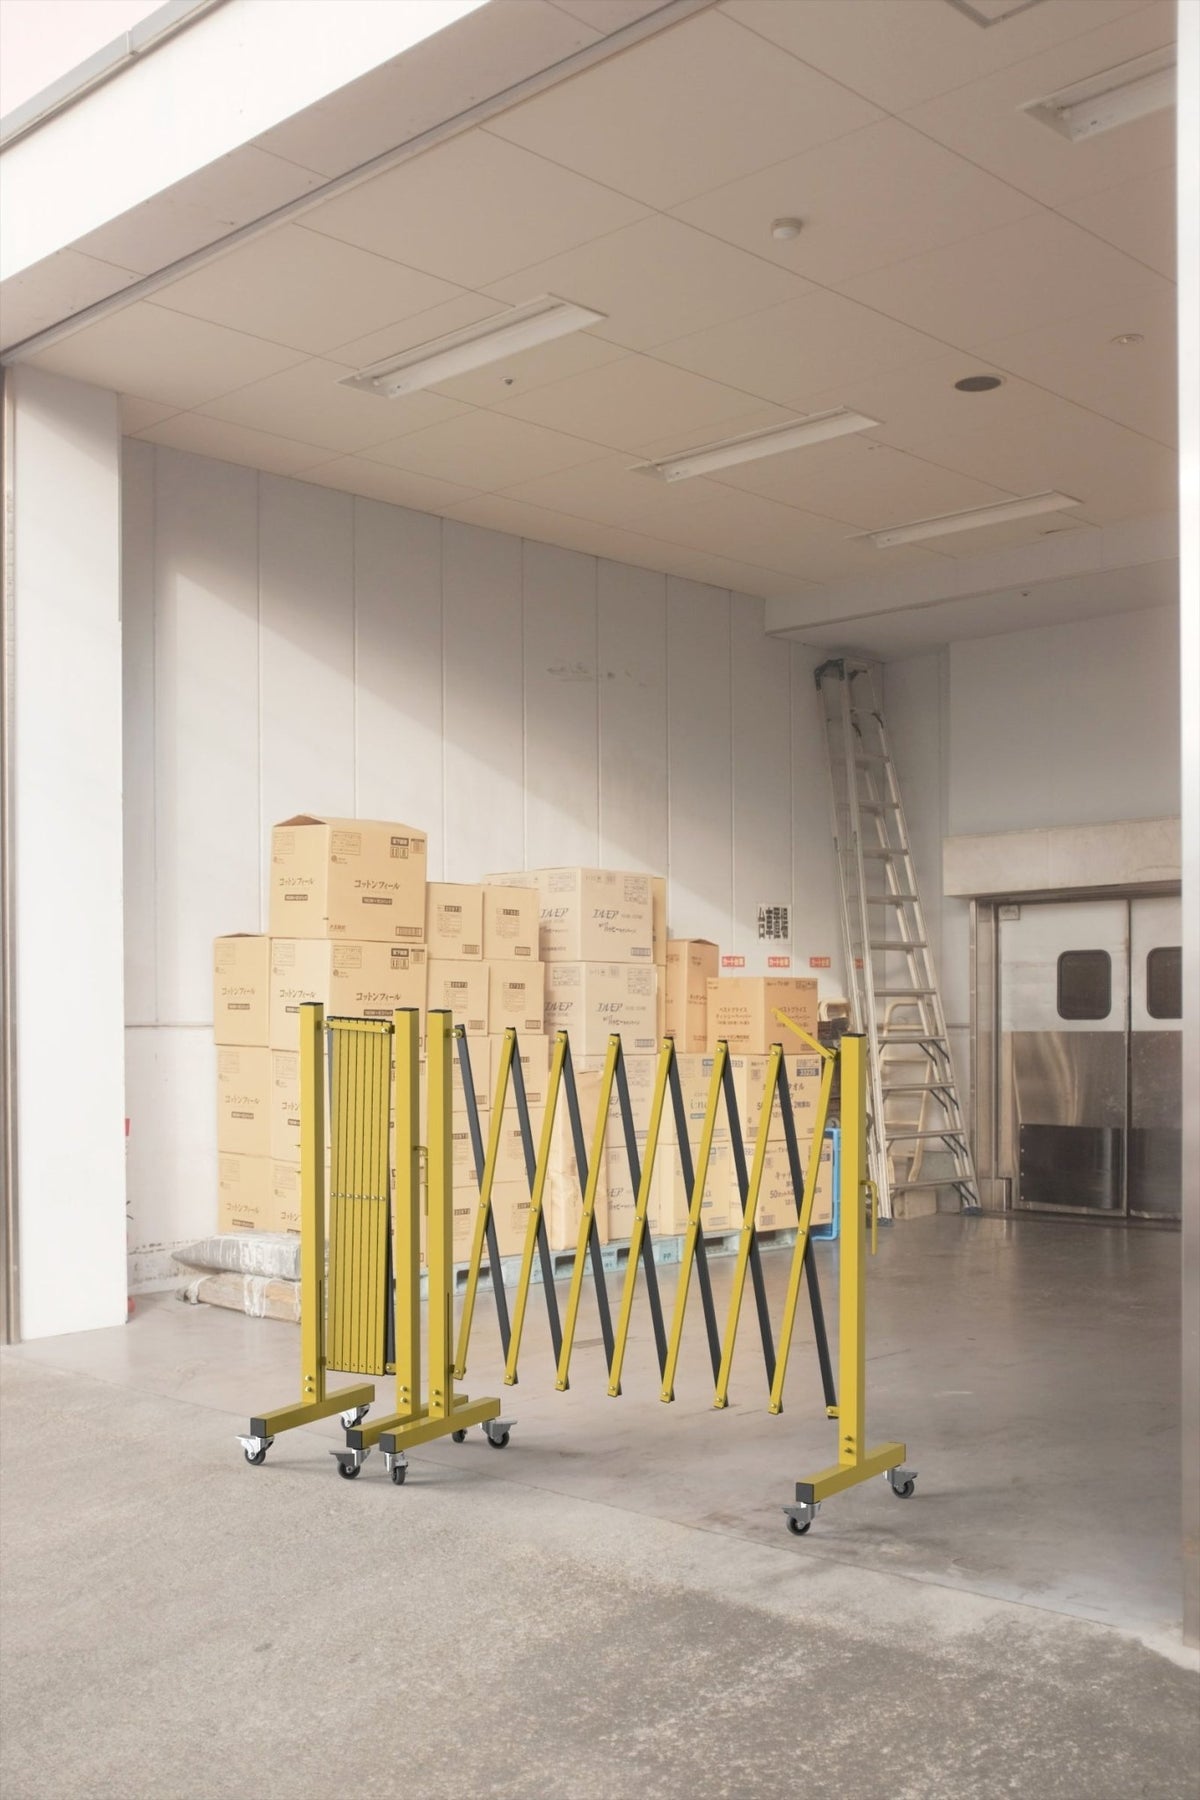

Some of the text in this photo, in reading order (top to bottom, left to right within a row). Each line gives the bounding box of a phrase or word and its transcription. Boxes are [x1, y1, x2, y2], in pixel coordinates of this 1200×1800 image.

[279, 877, 314, 886] コットンフィール
[354, 880, 400, 890] コットンフィール
[279, 989, 317, 998] コットンフィール
[356, 992, 401, 1001] コットンフィール
[225, 1095, 260, 1104] コットンフィール
[281, 1101, 300, 1111] コットン
[226, 1203, 260, 1213] コットンフィール
[280, 1211, 301, 1220] コットン
